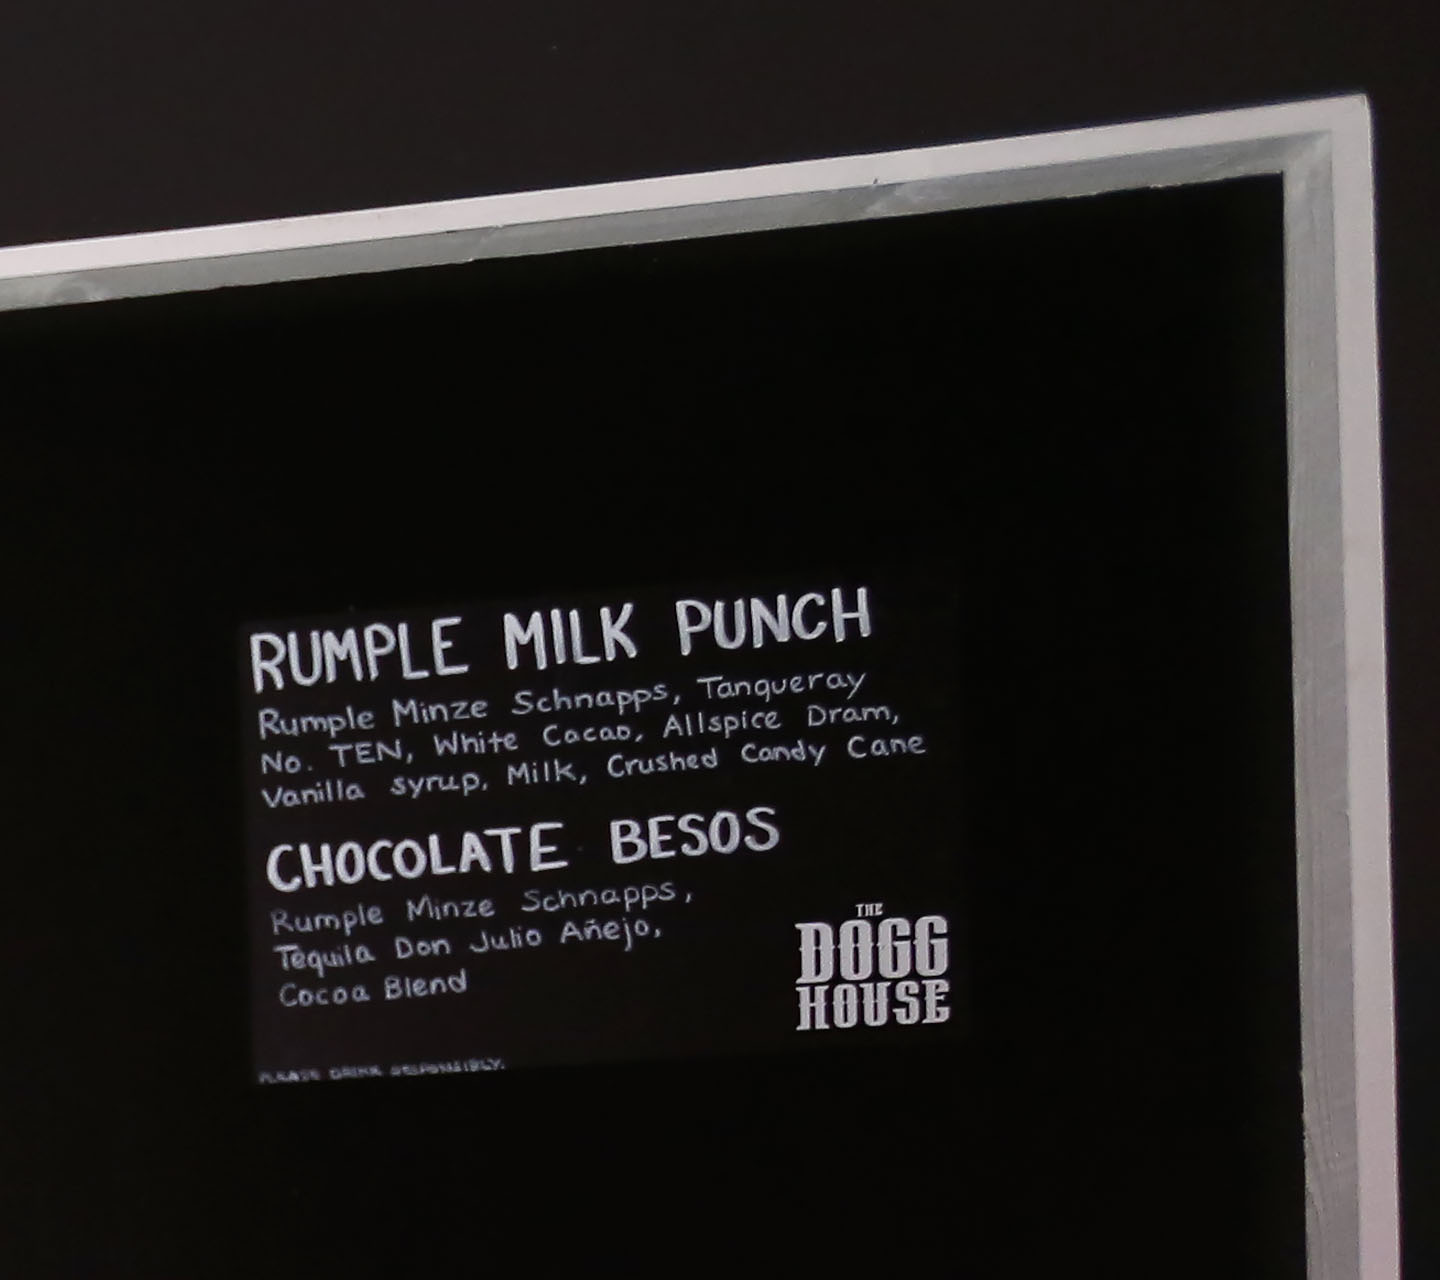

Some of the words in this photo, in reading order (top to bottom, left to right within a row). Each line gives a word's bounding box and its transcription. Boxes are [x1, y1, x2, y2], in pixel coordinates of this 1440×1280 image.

[249, 615, 470, 694] RUMPLE
[503, 602, 638, 671] MILK
[675, 586, 872, 657] PUNCH
[258, 705, 375, 740] Rumple
[391, 698, 488, 728] Minze
[511, 683, 681, 716] Schnapps,
[696, 672, 866, 703] Tanqueray
[260, 751, 312, 775] No.
[327, 738, 413, 768] TEN,
[433, 730, 519, 756] White
[542, 724, 644, 747] Cacao,
[662, 710, 782, 739] Allspice
[807, 704, 899, 727] Dram,
[261, 779, 366, 809] Vanilla
[390, 772, 488, 799] syrup,
[507, 758, 587, 786] Milk,
[607, 747, 718, 778] Crushed
[740, 739, 826, 767] Candy
[847, 735, 926, 759] Cane
[266, 821, 569, 893] CHOCOLATE
[609, 806, 780, 865] BESOS
[271, 904, 384, 937] Rumple
[406, 895, 496, 921] Minze
[521, 882, 692, 912] Schnapps,
[855, 902, 884, 918] THE
[273, 943, 376, 978] Tequila
[394, 936, 451, 960] Don
[469, 927, 542, 953] Julio
[560, 918, 661, 952] Añejo,
[794, 914, 949, 985] DOGG
[279, 983, 371, 1007] Cocoa
[384, 968, 468, 1001] Blend
[795, 978, 951, 1031] HOUSE
